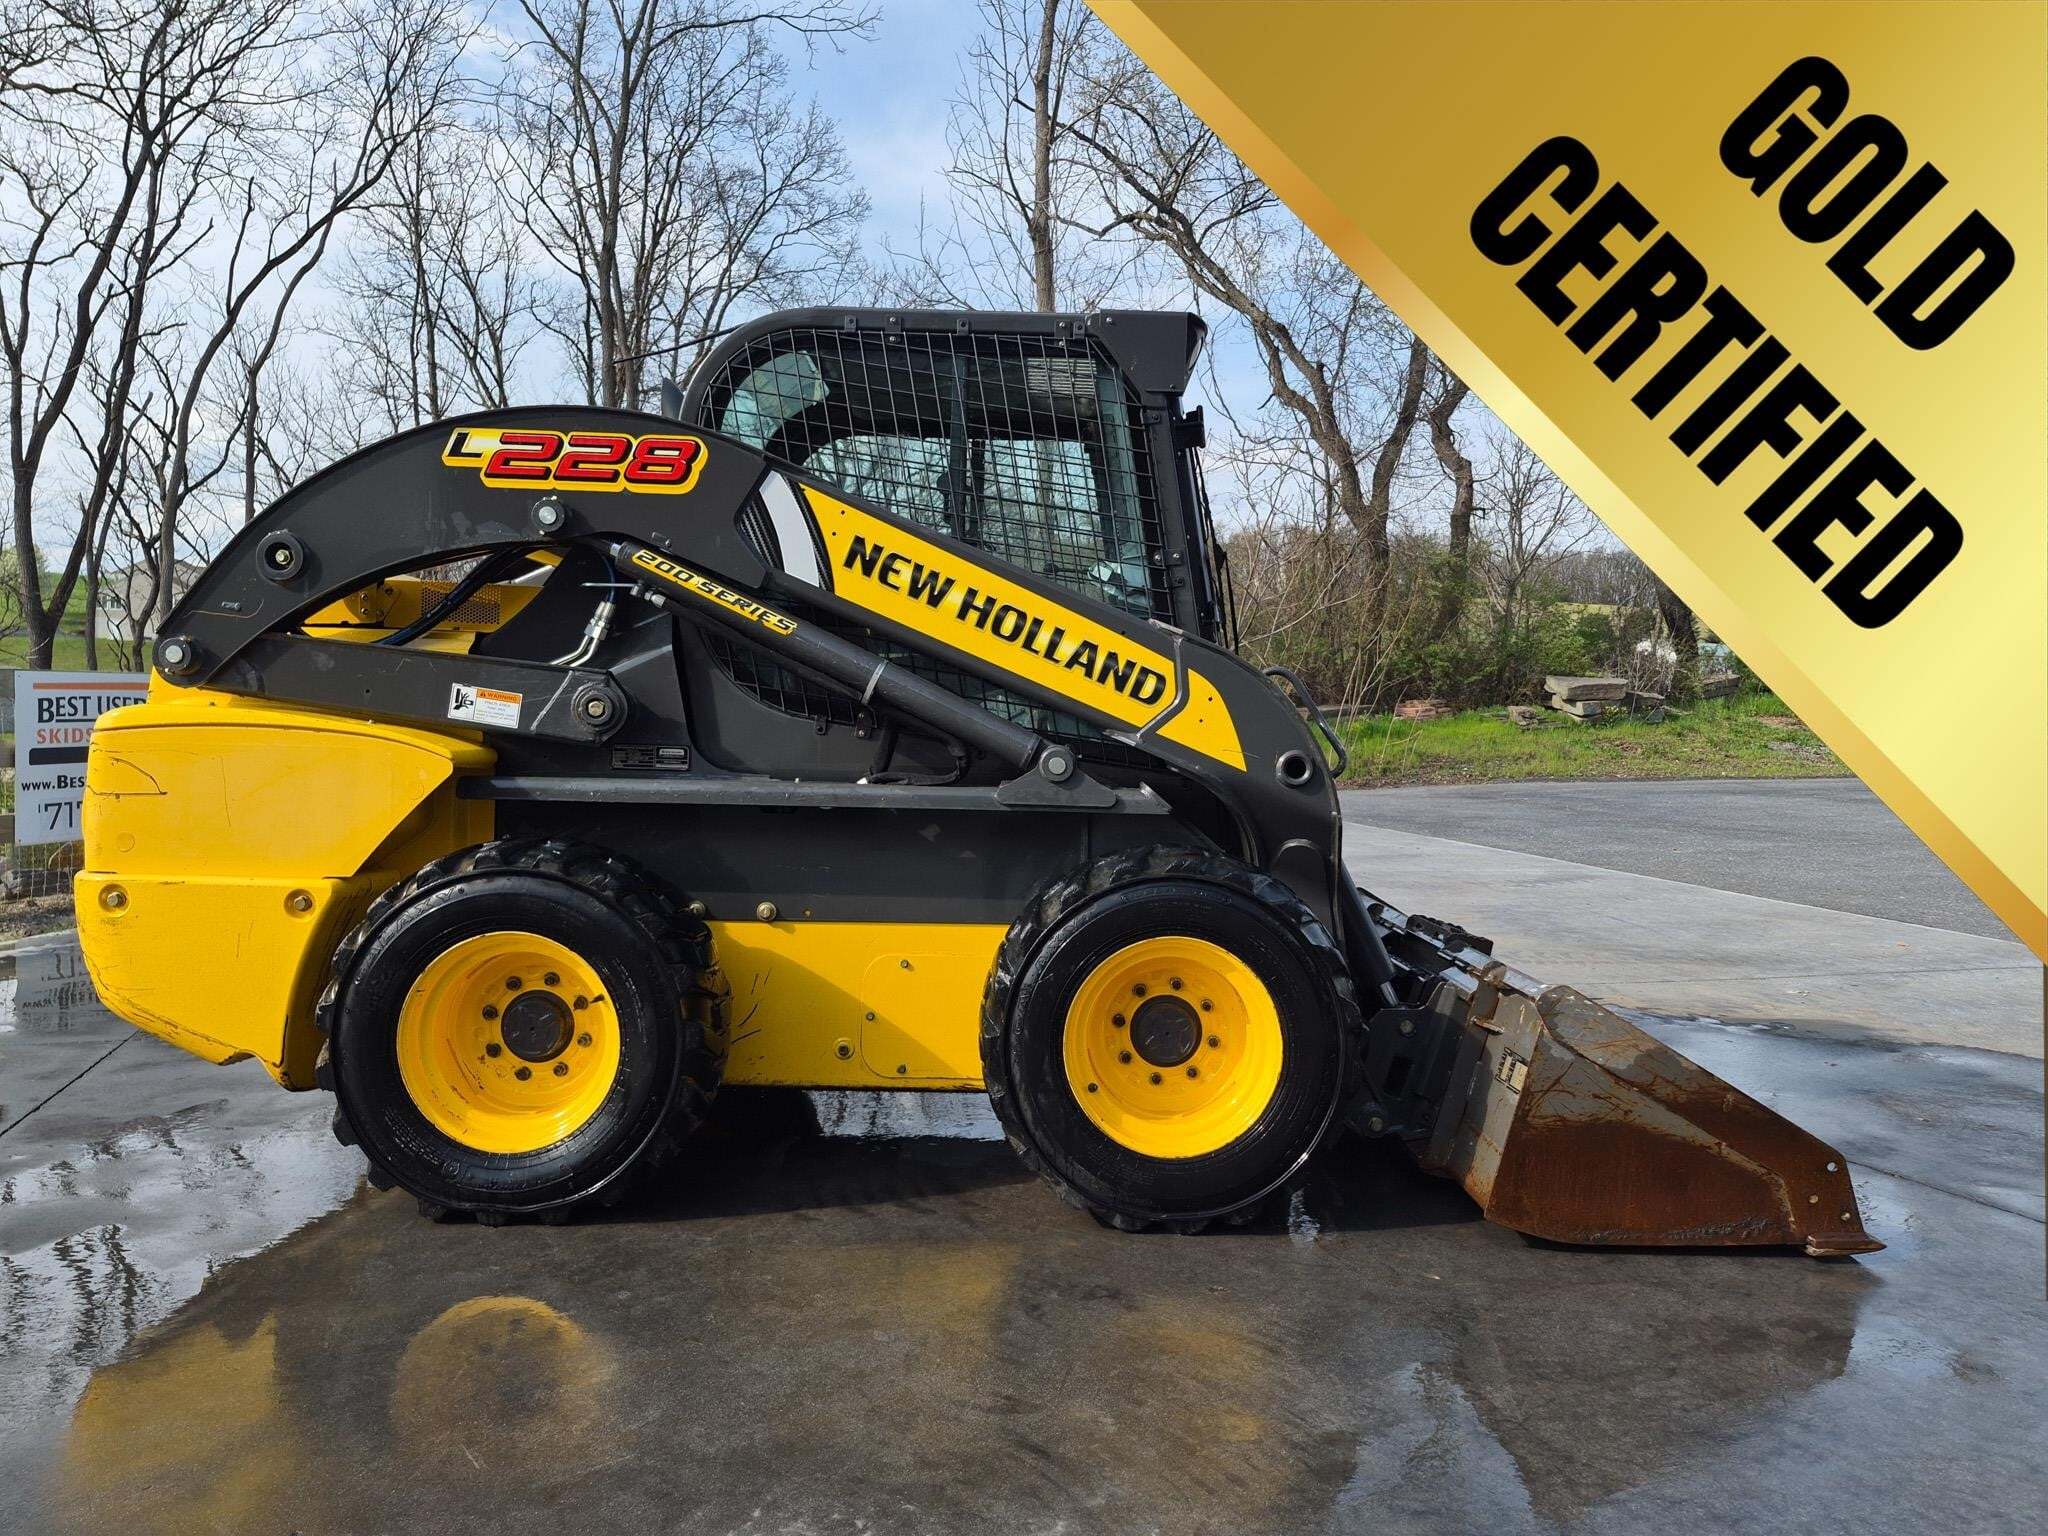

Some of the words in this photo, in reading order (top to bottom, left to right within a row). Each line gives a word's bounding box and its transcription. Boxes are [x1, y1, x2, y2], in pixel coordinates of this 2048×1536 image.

[447, 431, 702, 486] L228
[636, 551, 695, 583] 200
[696, 578, 798, 631] SERIES
[843, 535, 955, 608] NEW
[956, 587, 1167, 705] HOLLAND
[37, 695, 92, 724] BEST
